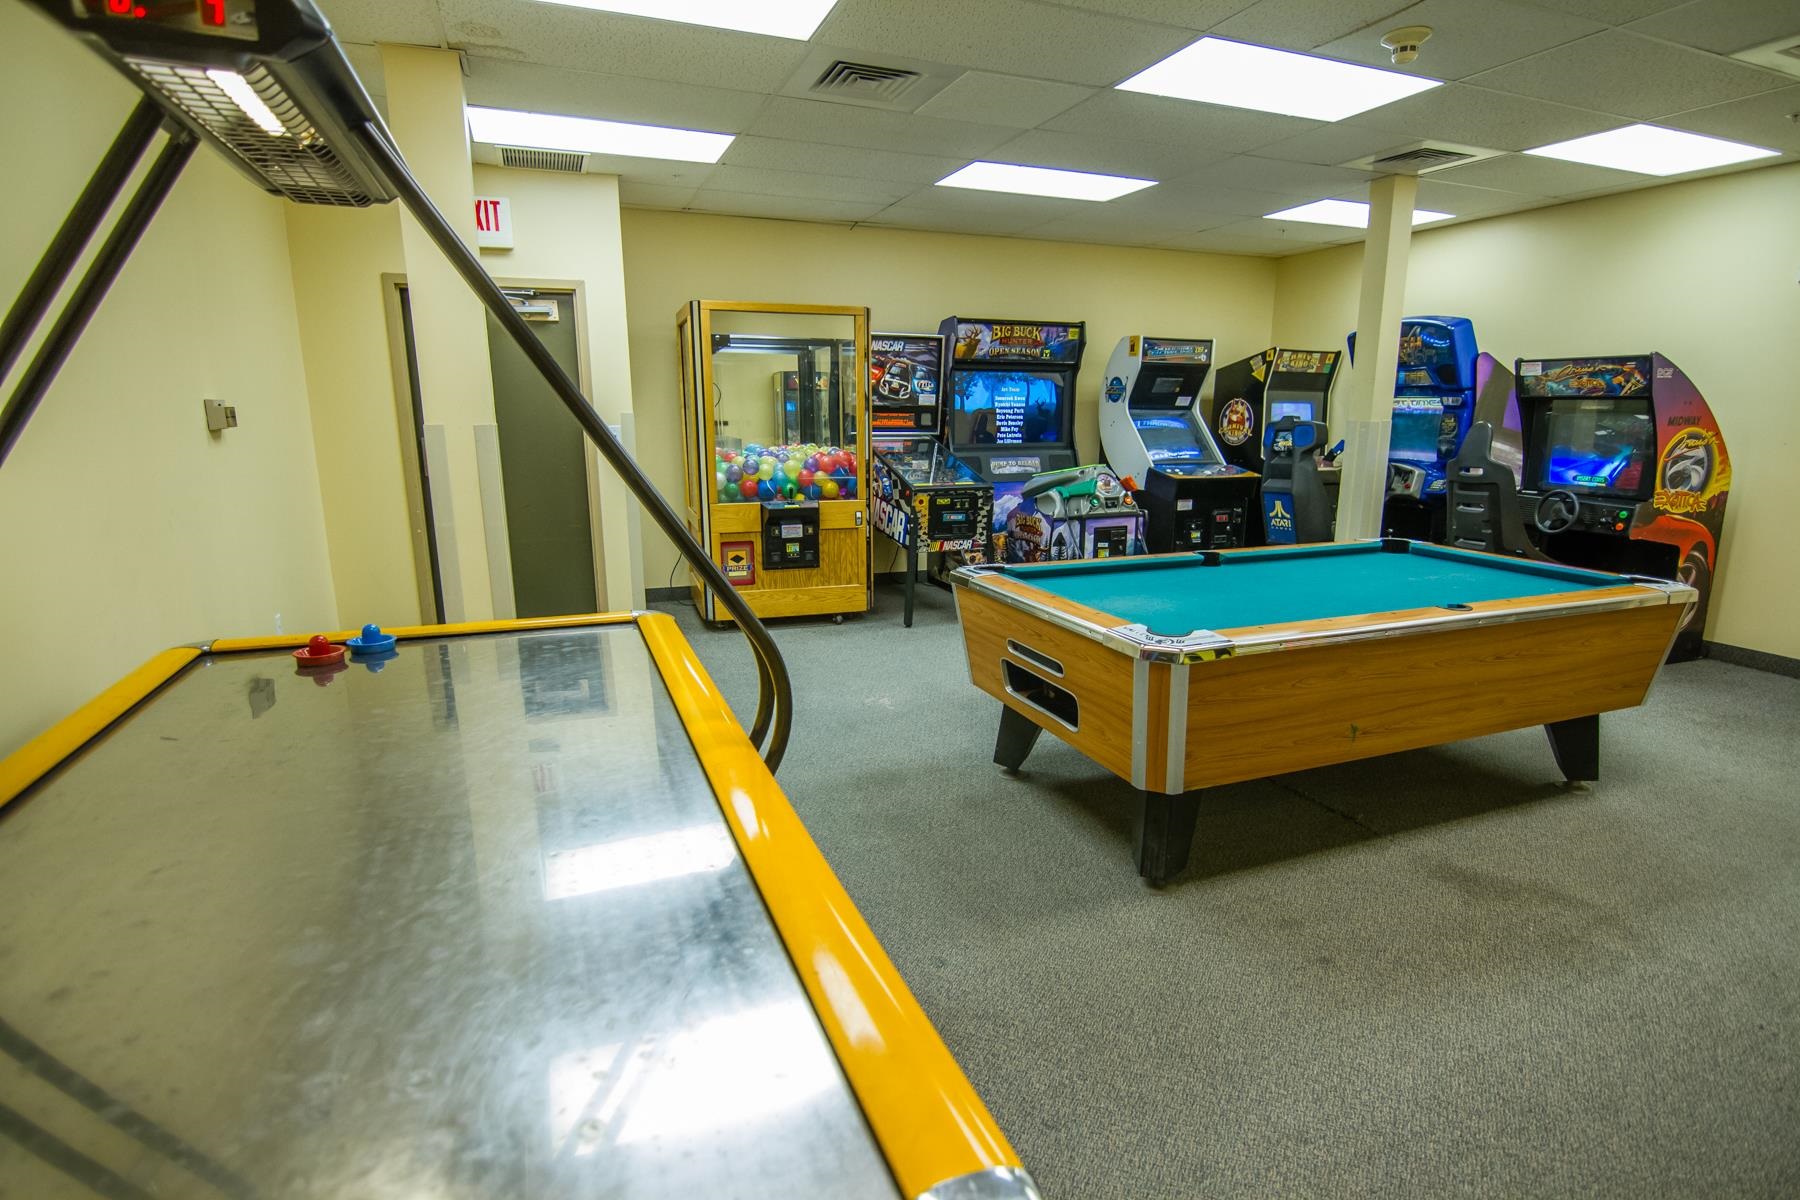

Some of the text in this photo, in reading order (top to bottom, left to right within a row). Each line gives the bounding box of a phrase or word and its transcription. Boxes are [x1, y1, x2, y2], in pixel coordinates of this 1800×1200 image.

[475, 199, 500, 232] XIT
[992, 325, 1041, 340] BIG BUCK
[871, 340, 904, 352] NASCAR
[989, 346, 1041, 357] OPEN SEASON
[1667, 415, 1702, 427] MIDWAY
[873, 495, 906, 545] ASCAR
[1270, 519, 1292, 528] ATARI
[943, 540, 972, 551] NASCAR
